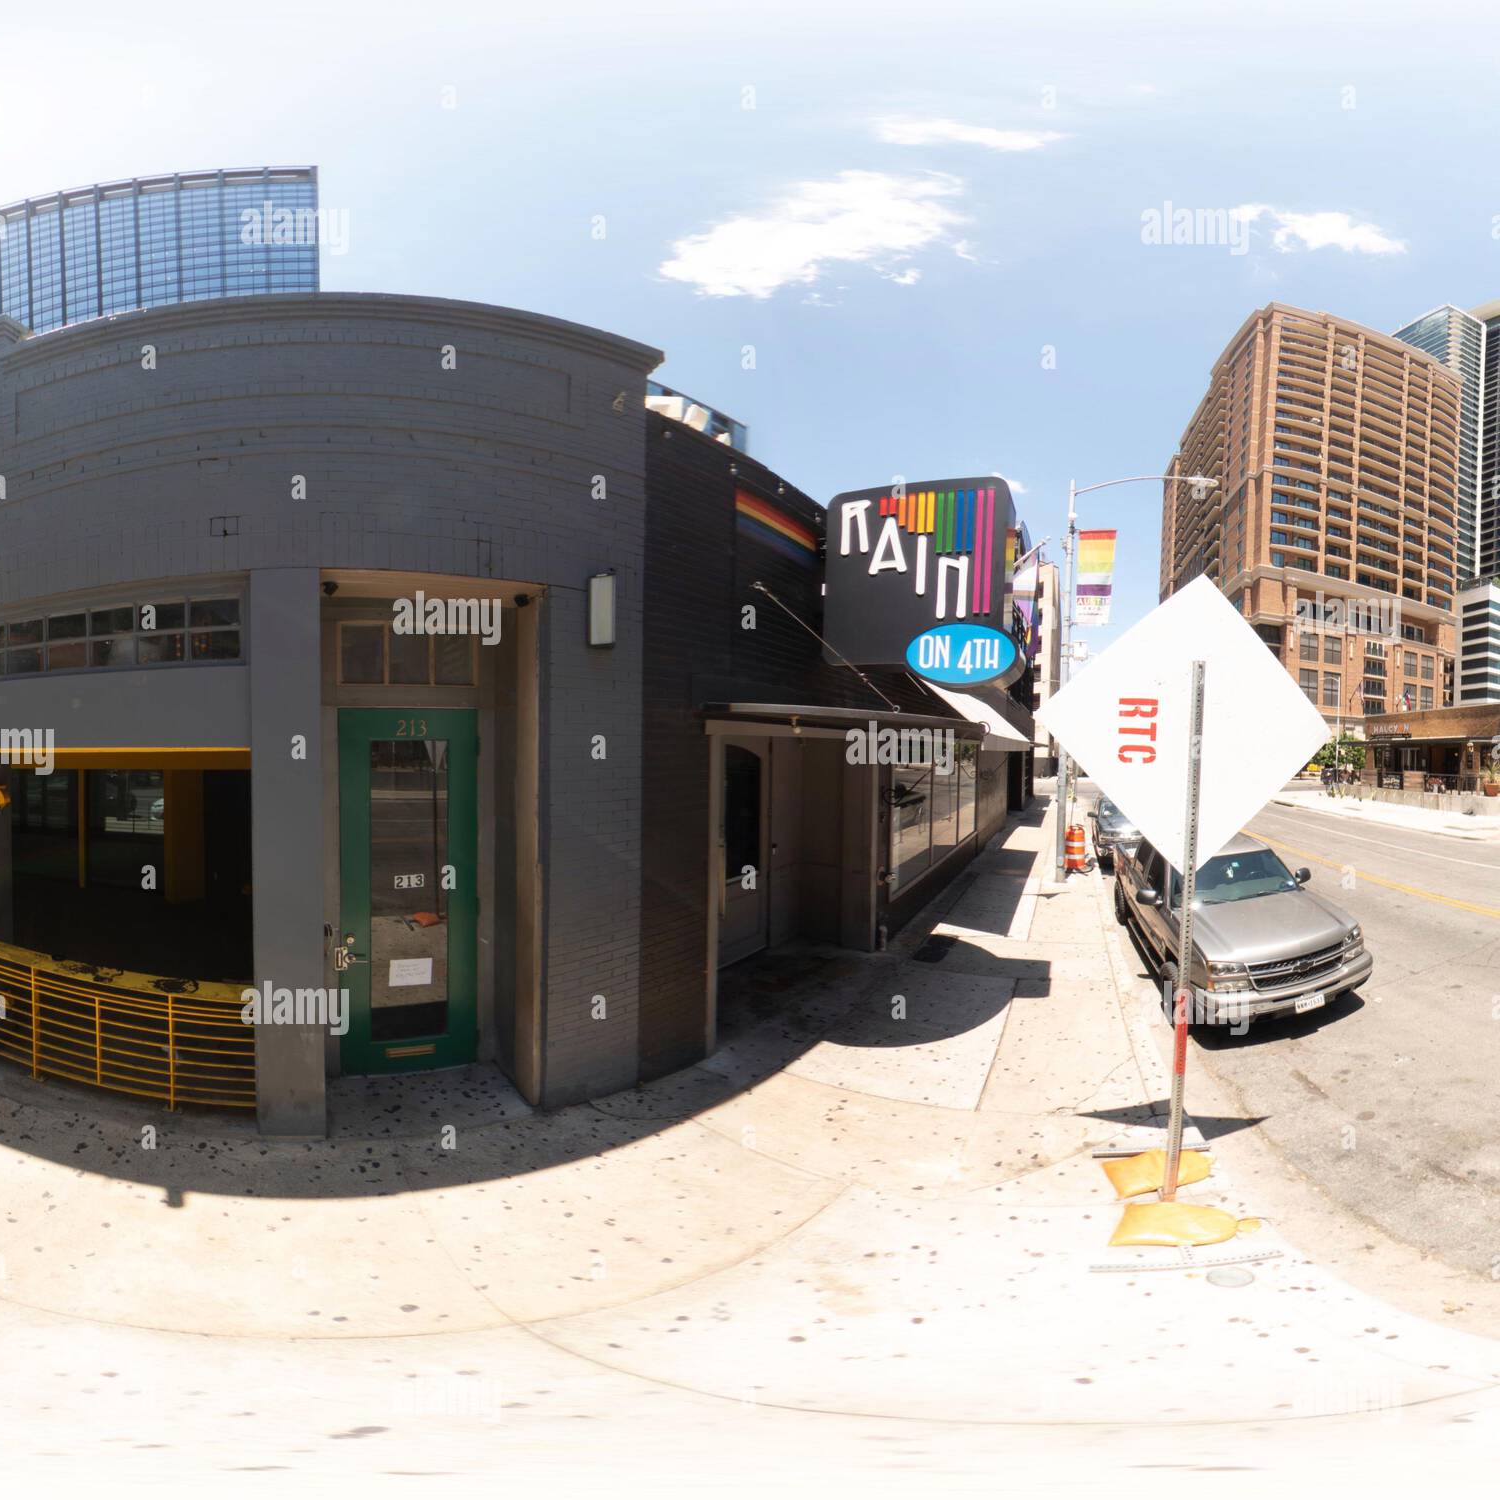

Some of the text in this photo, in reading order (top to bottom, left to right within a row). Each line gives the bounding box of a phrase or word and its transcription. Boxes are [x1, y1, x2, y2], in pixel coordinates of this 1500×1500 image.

[840, 500, 969, 619] RAIN
[918, 635, 1000, 674] ON 4TH
[396, 719, 427, 736] 213
[1118, 698, 1158, 763] RTC
[395, 875, 424, 888] 213
